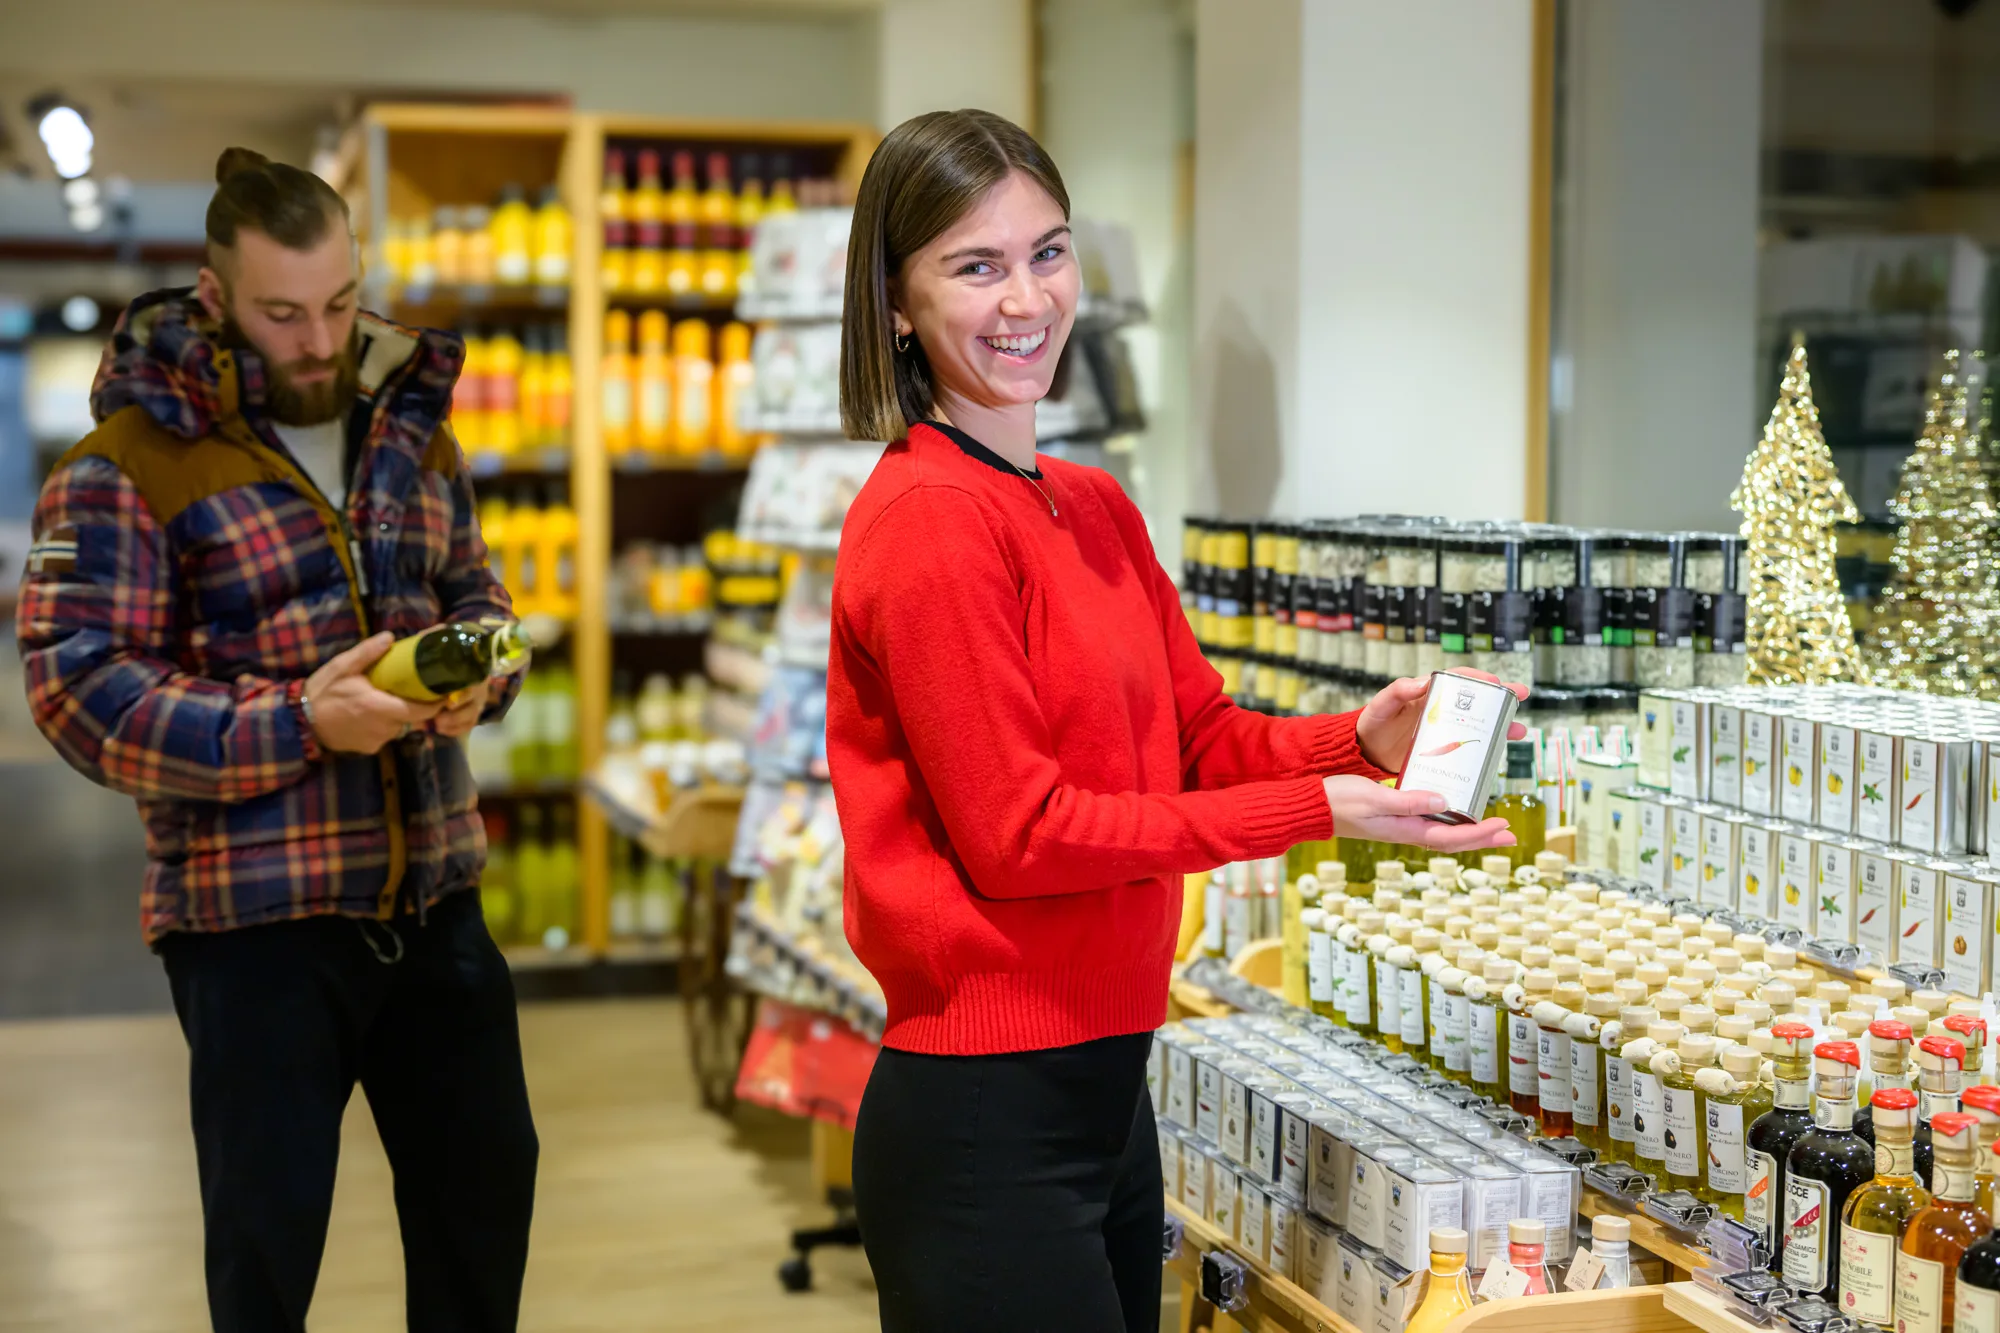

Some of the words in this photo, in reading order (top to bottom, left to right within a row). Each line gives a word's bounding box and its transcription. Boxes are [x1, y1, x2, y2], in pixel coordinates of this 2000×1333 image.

[1412, 763, 1471, 783] PEPERONCINO
[1673, 1152, 1692, 1160] NERO
[1711, 1167, 1739, 1176] PORCINO
[1848, 1261, 1872, 1277] NOBILE
[1903, 1289, 1920, 1304] ROSA
